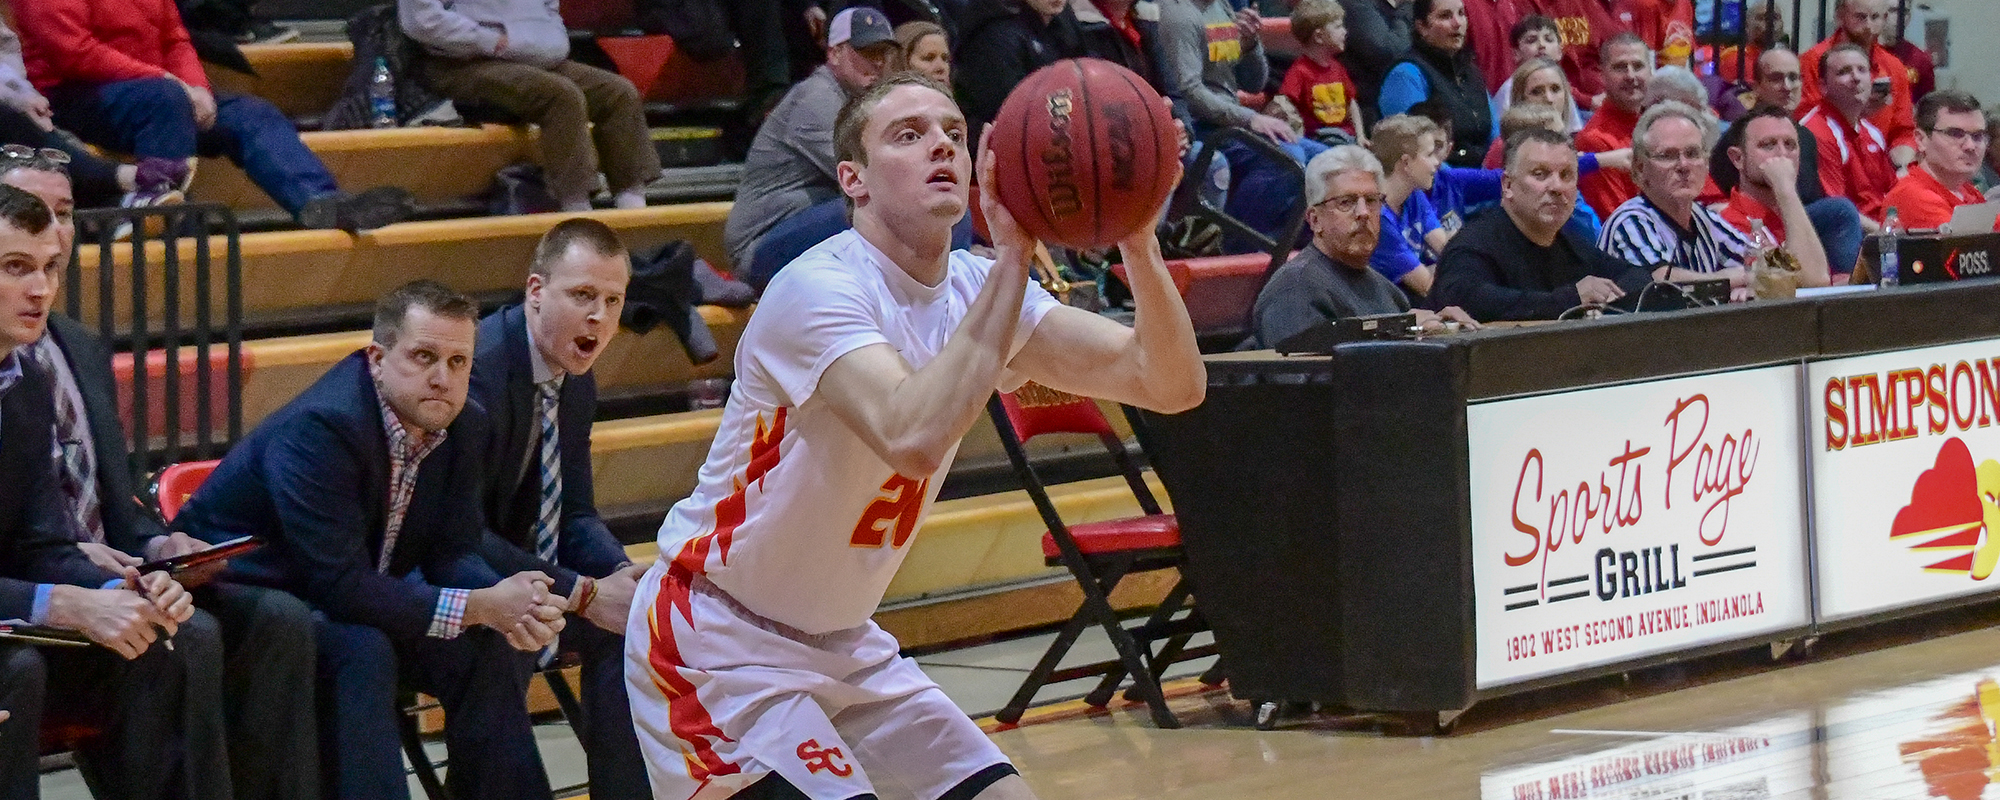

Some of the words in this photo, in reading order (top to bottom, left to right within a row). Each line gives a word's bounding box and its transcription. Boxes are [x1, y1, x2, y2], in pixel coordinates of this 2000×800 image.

[1042, 87, 1084, 220] Wilson
[1959, 250, 1990, 275] POSS.
[1824, 357, 2000, 452] SIMPSON
[1504, 439, 1651, 600] Sports
[1664, 393, 1760, 546] Page
[1595, 543, 1686, 602] GRILL
[1507, 634, 1536, 662] 1802
[1541, 625, 1580, 654] WEST
[1585, 615, 1633, 646] SECOND
[1639, 605, 1692, 636] AVENUE,
[1695, 591, 1765, 626] INDIANOLA
[796, 738, 853, 778] SC
